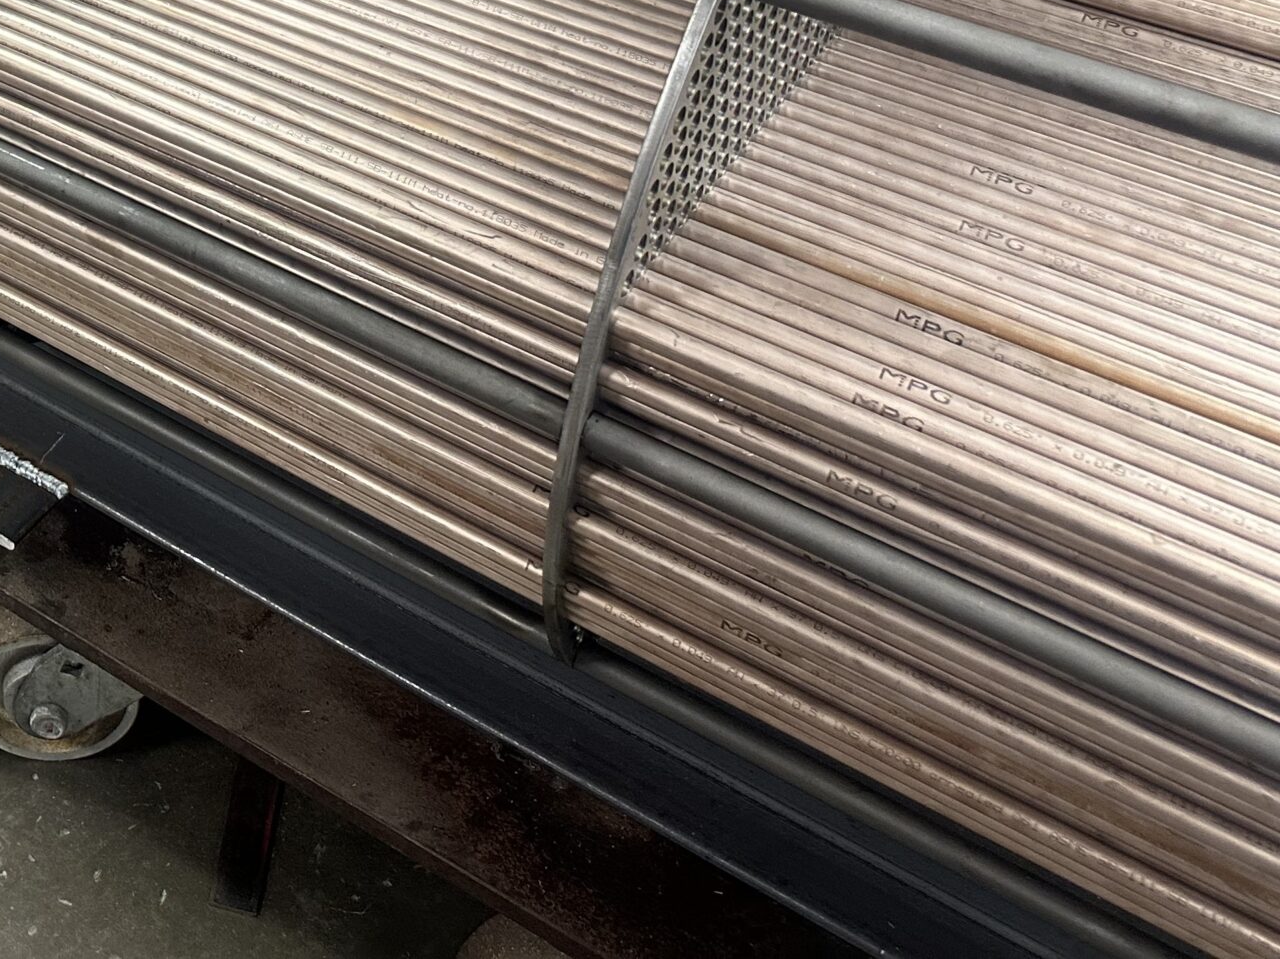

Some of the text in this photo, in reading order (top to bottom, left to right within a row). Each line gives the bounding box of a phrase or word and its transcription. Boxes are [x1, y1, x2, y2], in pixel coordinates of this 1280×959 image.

[1081, 13, 1139, 38] MPG
[970, 163, 1034, 197] MPG
[533, 229, 566, 249] Made
[574, 247, 590, 259] in
[958, 218, 1026, 253] MPG
[894, 306, 966, 347] MPG
[878, 366, 953, 407] MPG
[851, 391, 926, 432] MPG
[825, 468, 899, 512] MPG
[719, 618, 784, 658] MPG
